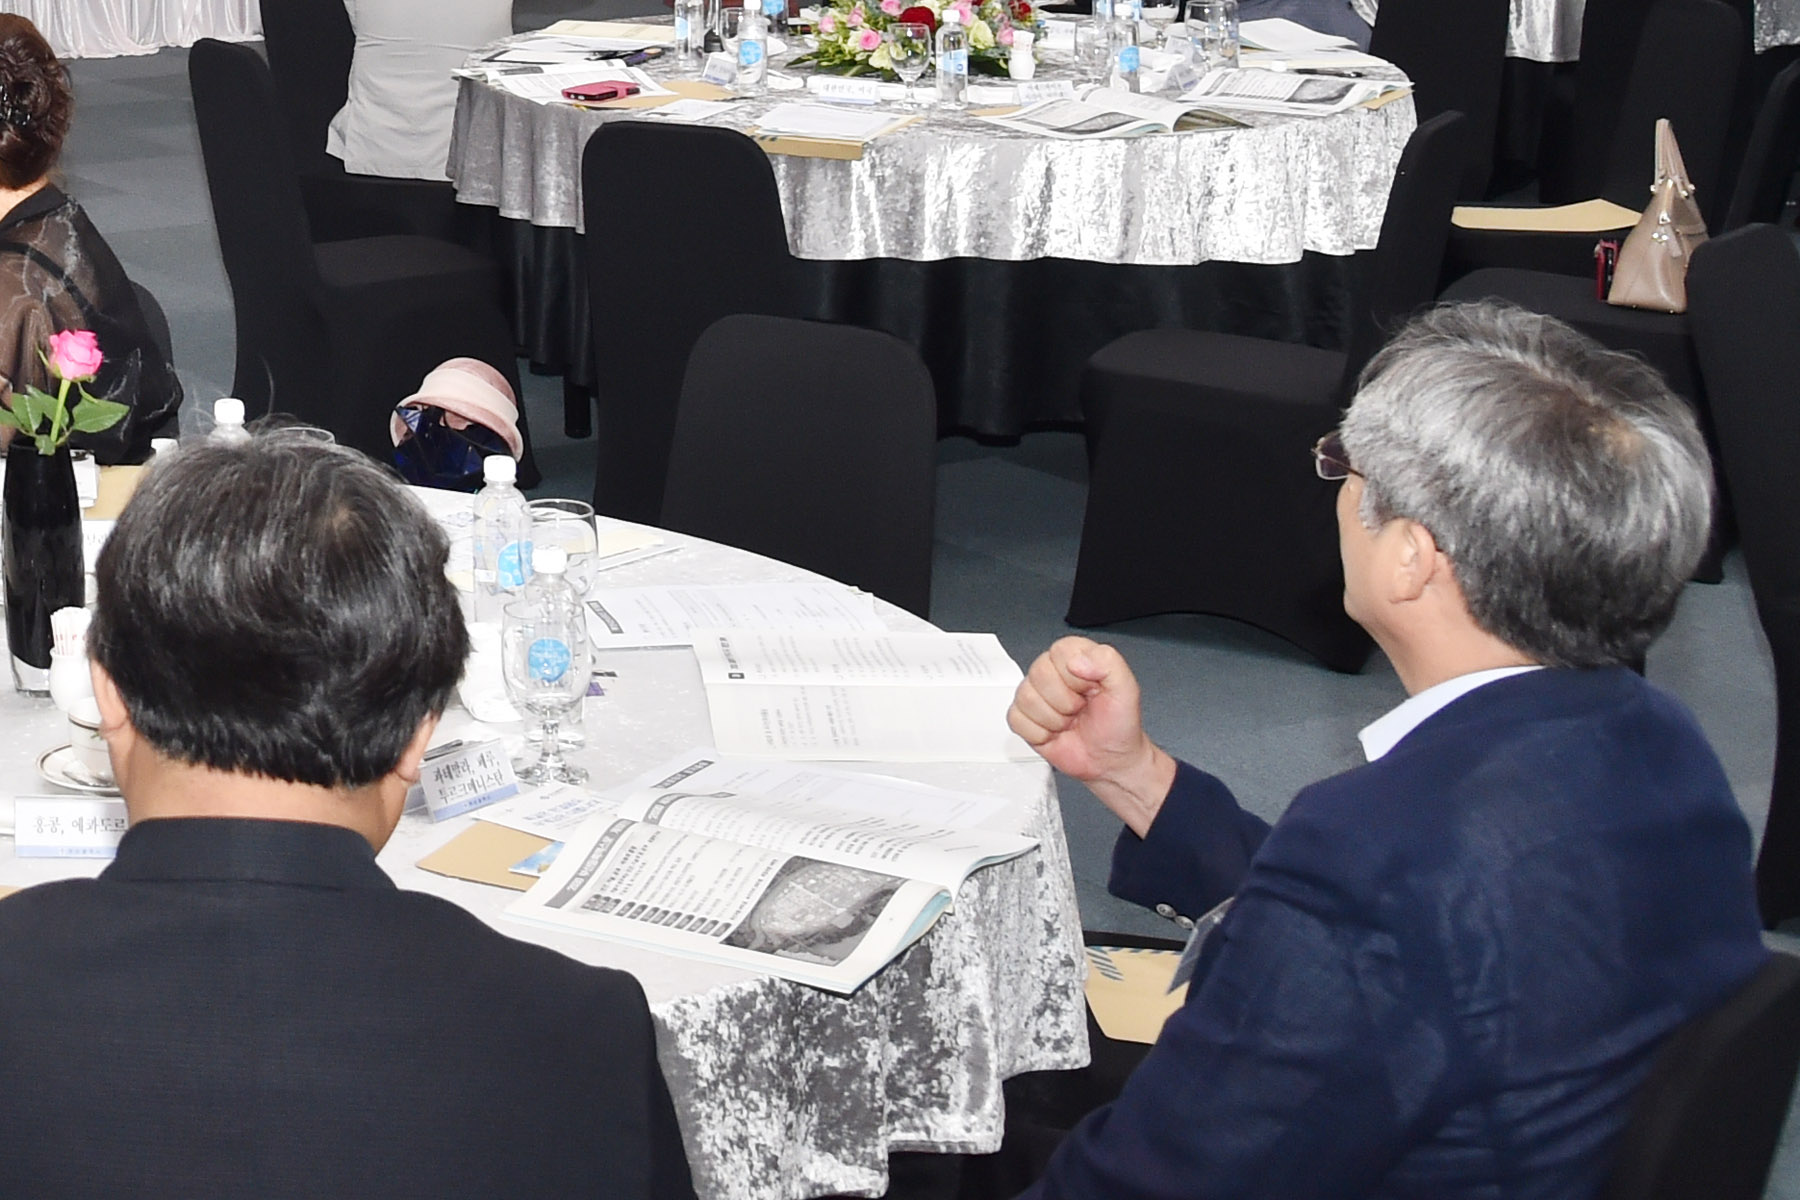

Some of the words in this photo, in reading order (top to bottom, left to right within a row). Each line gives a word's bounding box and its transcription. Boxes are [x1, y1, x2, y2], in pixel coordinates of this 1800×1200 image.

[438, 768, 505, 805] 투르크메니스탄
[32, 815, 65, 836] 홍콩,
[71, 815, 129, 835] 에콰도르
